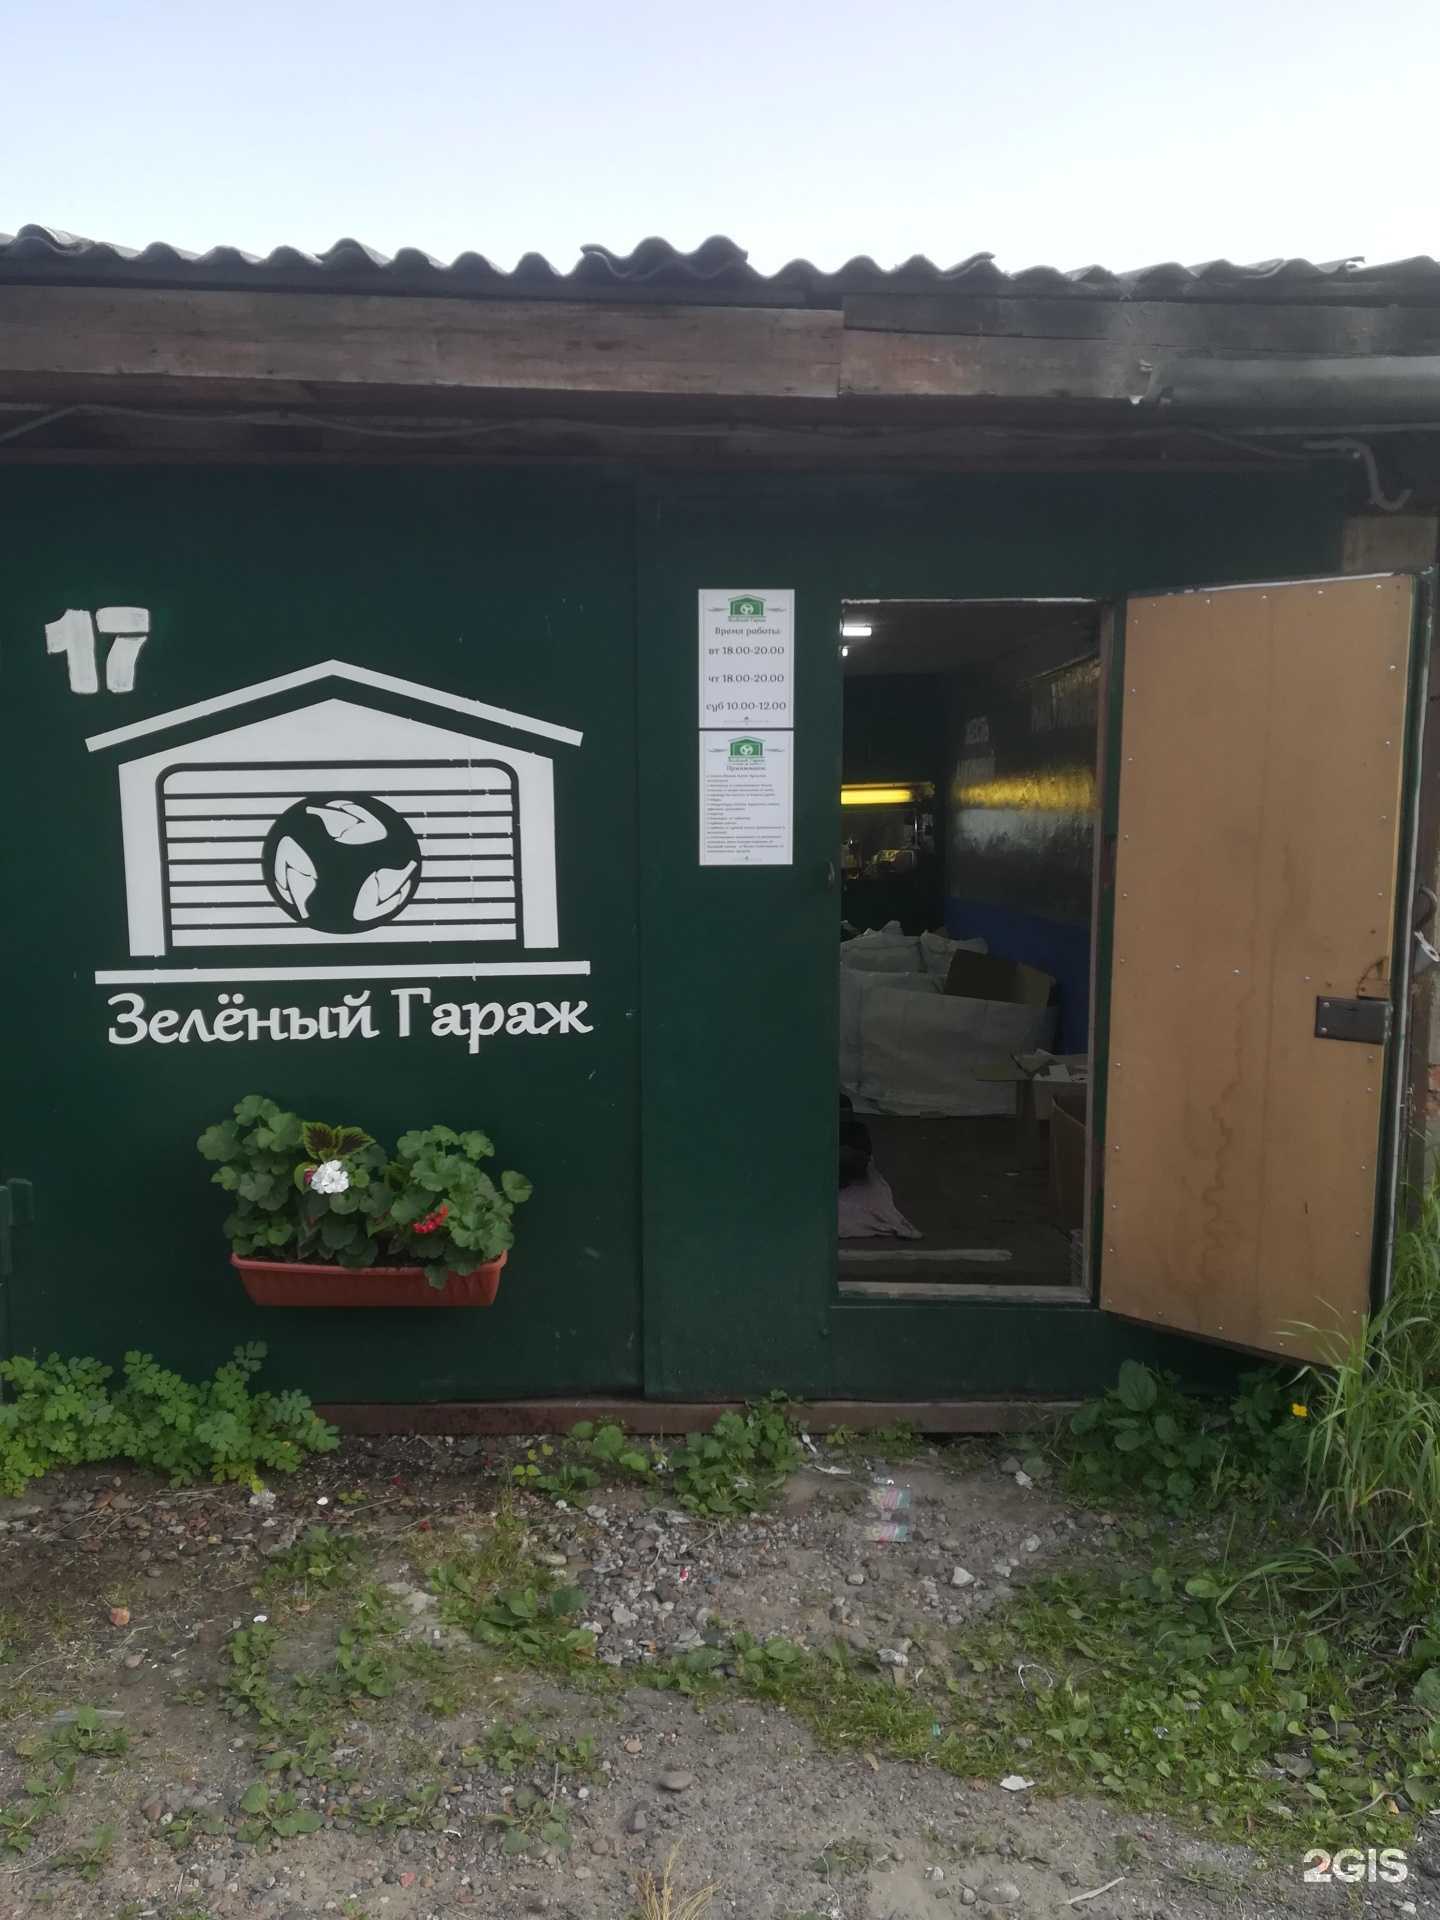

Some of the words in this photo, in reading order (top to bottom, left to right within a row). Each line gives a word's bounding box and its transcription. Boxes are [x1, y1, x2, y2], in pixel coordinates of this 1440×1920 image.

[714, 627, 744, 638] Время
[45, 606, 150, 693] 17
[722, 646, 785, 655] 18.00-20.00
[722, 674, 785, 683] 18.00-20.00
[706, 701, 724, 712] суб
[726, 702, 787, 711] 10.00-12.00
[107, 990, 380, 1044] Зелёный
[390, 987, 594, 1054] Гараж
